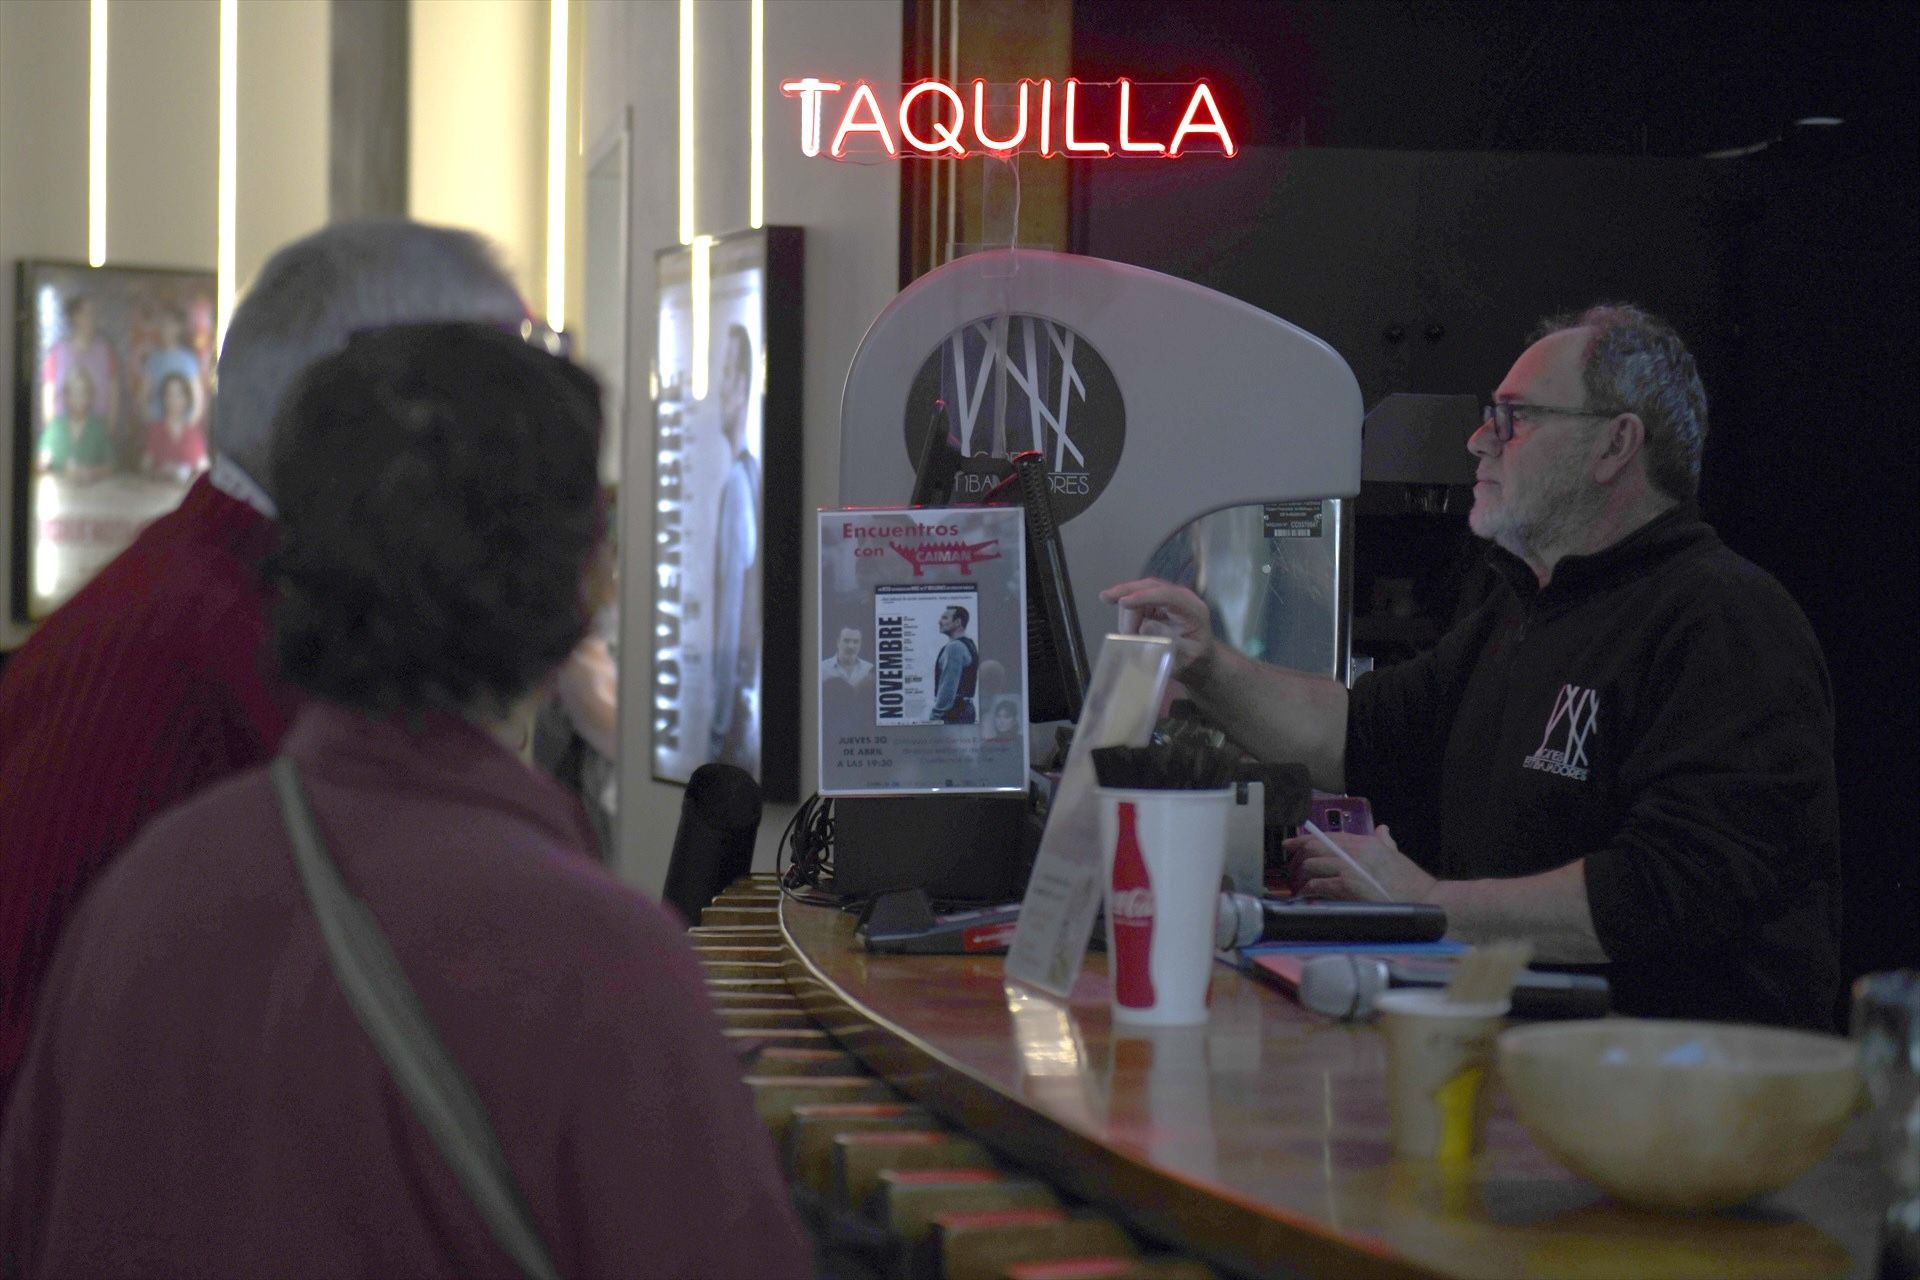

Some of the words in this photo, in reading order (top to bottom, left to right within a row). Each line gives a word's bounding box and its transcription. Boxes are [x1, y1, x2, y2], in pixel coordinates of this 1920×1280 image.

[782, 78, 1236, 157] TAQUILLA
[842, 523, 959, 539] Encuentros
[854, 546, 885, 558] con
[878, 616, 904, 720] NOVEMBRE
